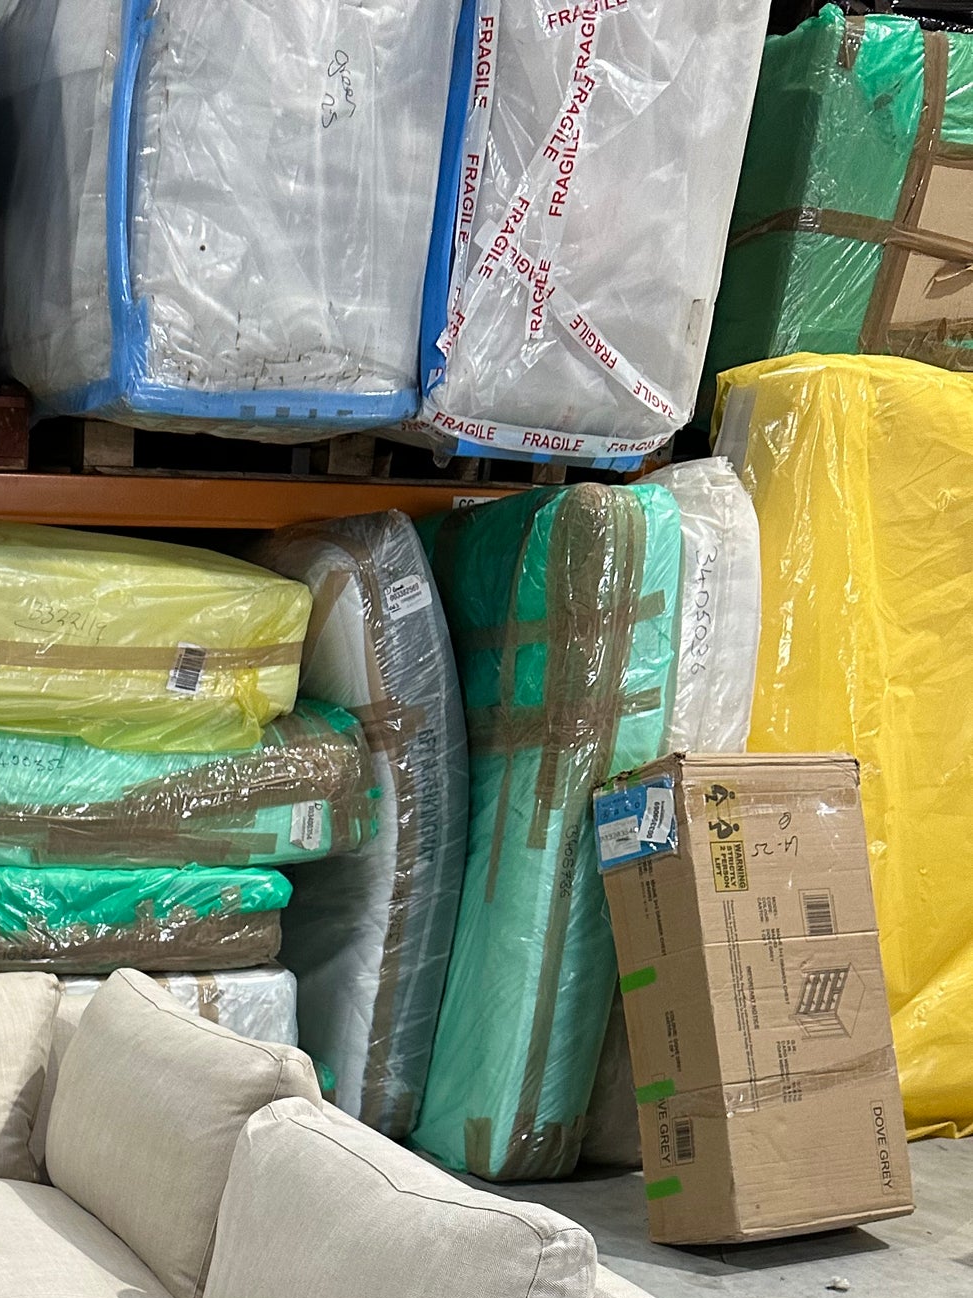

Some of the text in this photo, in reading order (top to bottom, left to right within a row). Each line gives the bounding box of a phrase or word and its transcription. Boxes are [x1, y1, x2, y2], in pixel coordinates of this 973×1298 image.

[473, 16, 494, 109] FRAGILE
[542, 75, 596, 162] FRAGILE
[459, 153, 479, 243] FRAGILE
[478, 196, 530, 279] FRAGILE
[530, 259, 552, 340] FRAGILE
[569, 313, 618, 369] FRAGILE
[432, 411, 497, 441] FRAGILE
[521, 432, 585, 452] FRAGILE
[606, 436, 669, 453] FRAGILE
[714, 857, 722, 877] LIFT
[720, 852, 731, 888] PERSON
[726, 845, 737, 887] STRICTLY
[734, 843, 746, 889] WARNING
[746, 965, 760, 1030] IMPORTANT NOTICE
[657, 1098, 672, 1164] VE GREY
[873, 1106, 893, 1189] DOVE GREY
